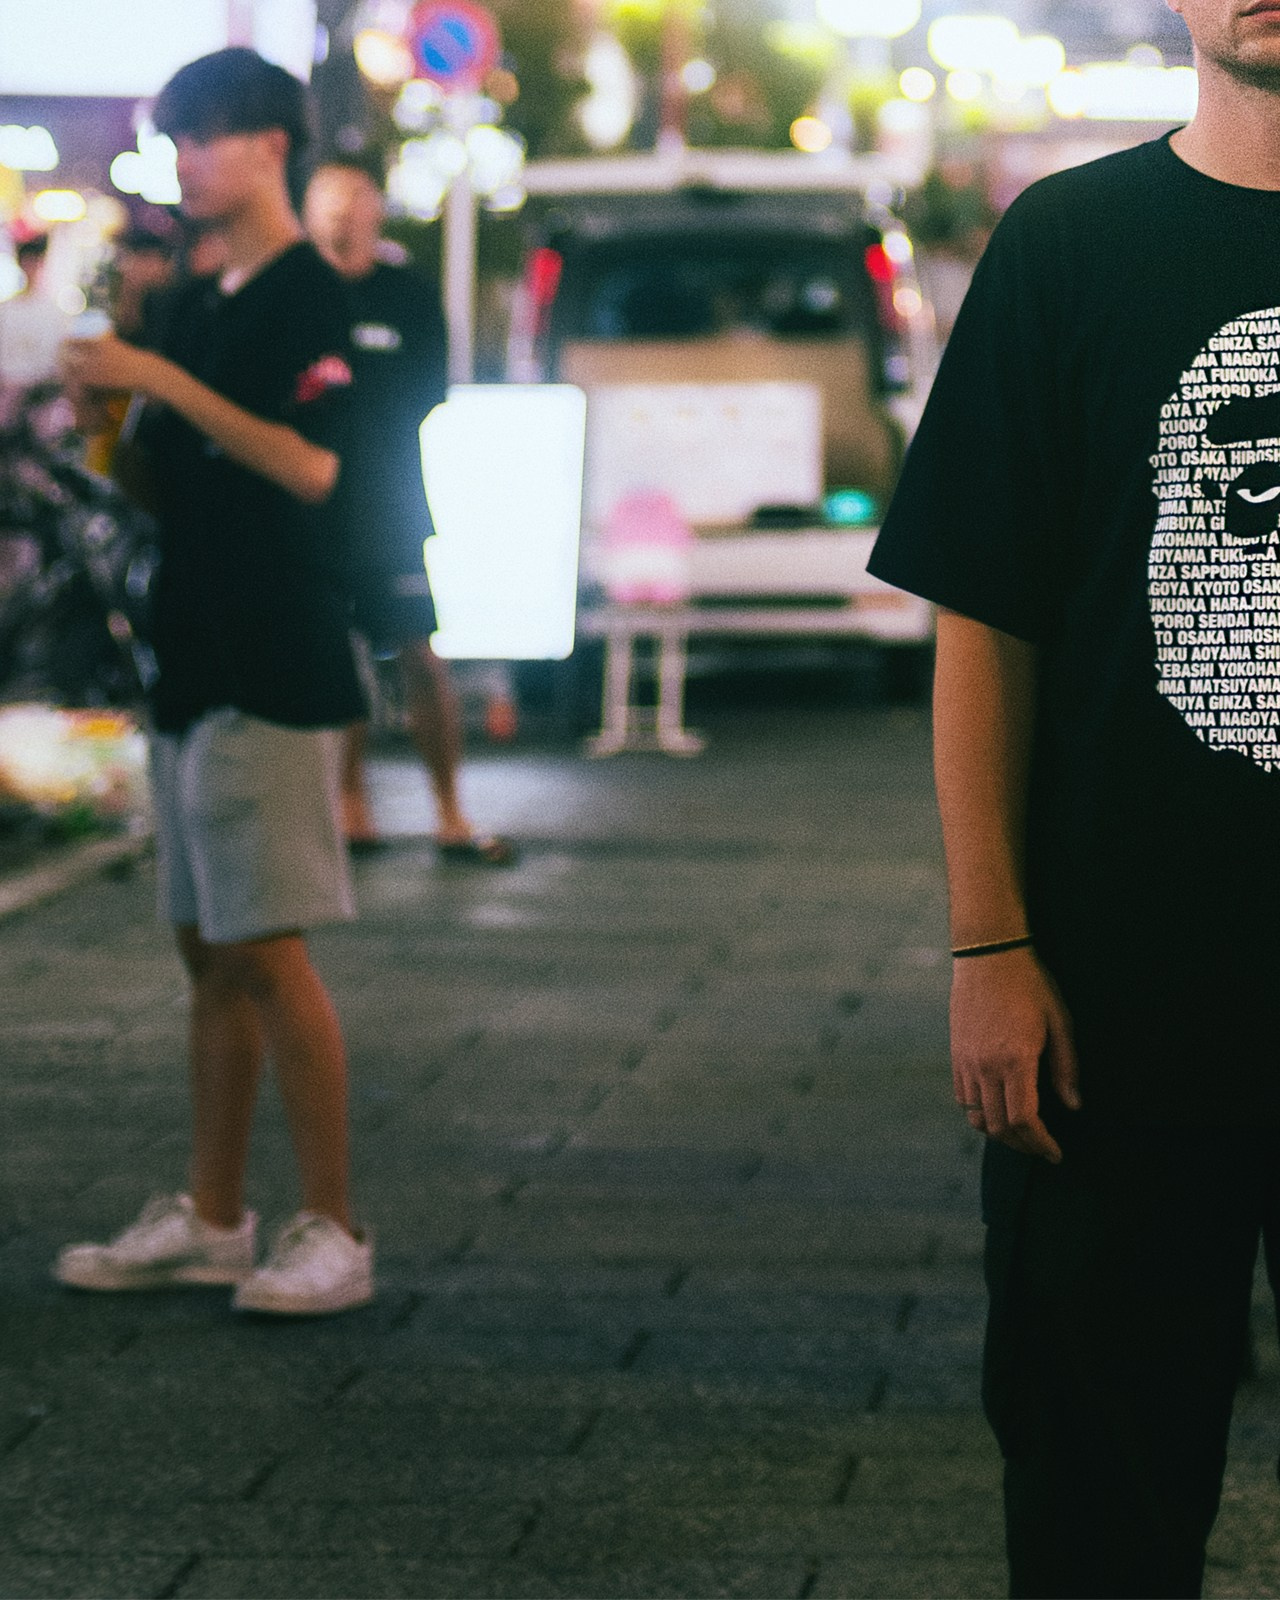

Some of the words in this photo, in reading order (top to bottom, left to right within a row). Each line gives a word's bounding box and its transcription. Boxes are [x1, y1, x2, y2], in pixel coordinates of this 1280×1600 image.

[1208, 336, 1253, 352] GINZA
[1221, 351, 1280, 367] NAGOYA
[1211, 367, 1278, 383] FUKUOKA
[1181, 384, 1251, 401] SAPPORO
[1158, 434, 1198, 451] PORO
[1181, 450, 1227, 465] OSAKA
[1148, 548, 1206, 564] SUYAMA
[1148, 565, 1177, 580] NZA
[1181, 563, 1247, 579] SAPPORO
[1193, 580, 1240, 595] KYOTO
[1198, 613, 1249, 628] SENDAI
[1177, 630, 1226, 645] OSAKA
[1191, 645, 1251, 661] AOYAMA
[1209, 695, 1252, 710] GINZA
[1220, 711, 1280, 726] NAGOYA
[1209, 728, 1277, 743] FUKUOKA
